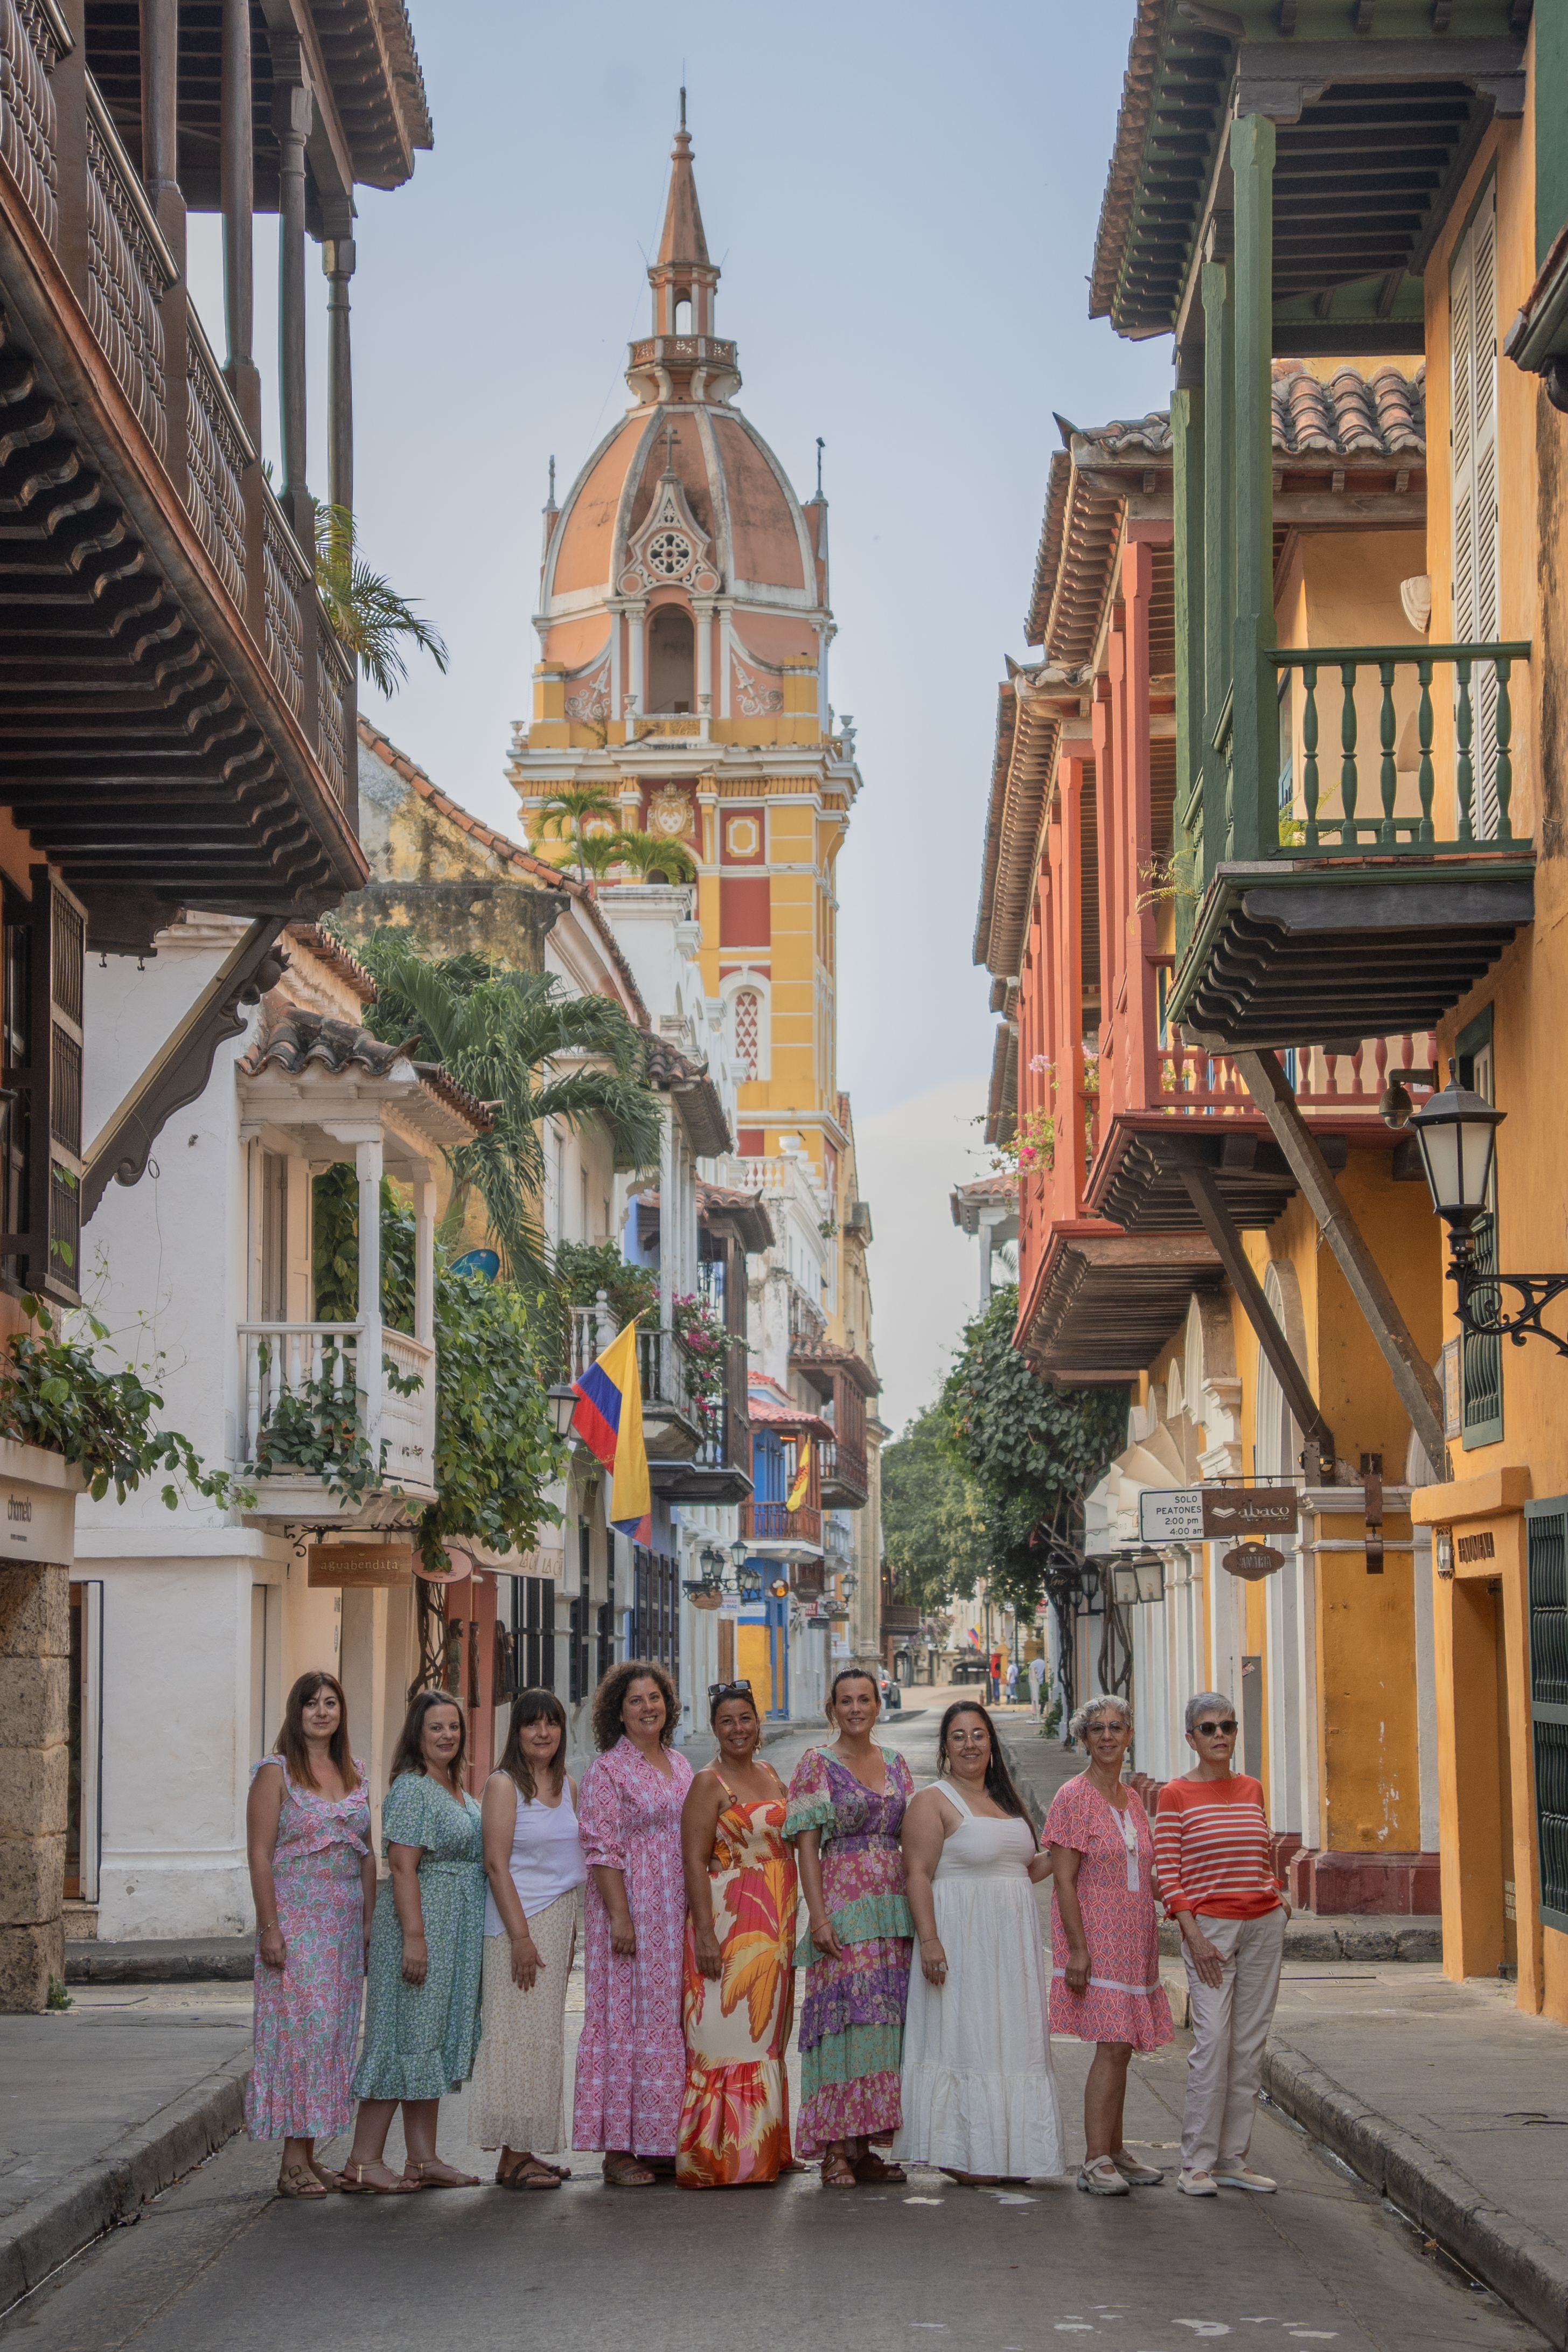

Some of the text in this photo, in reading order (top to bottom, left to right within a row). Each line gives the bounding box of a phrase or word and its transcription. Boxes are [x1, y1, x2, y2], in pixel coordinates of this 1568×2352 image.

[1156, 1506, 1202, 1515] PEATONES
[1165, 1517, 1184, 1525] 2:00
[320, 1560, 398, 1571] aguabendita
[542, 1558, 552, 1574] LA
